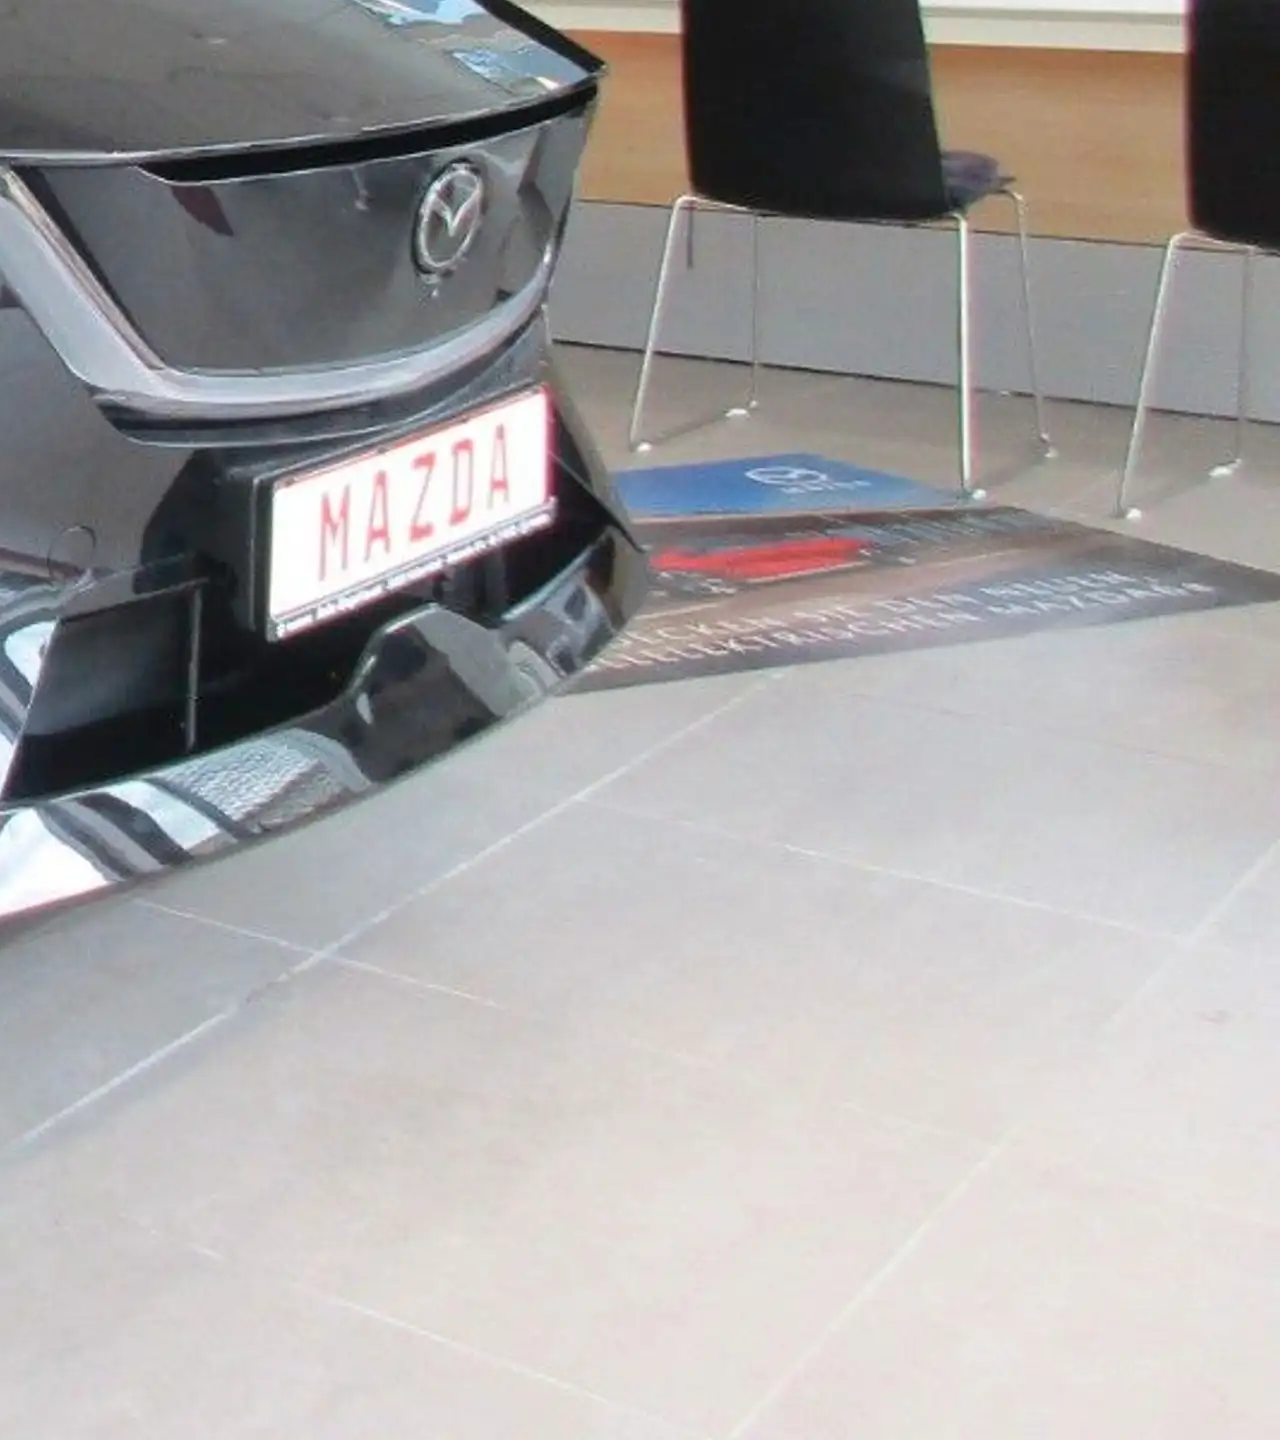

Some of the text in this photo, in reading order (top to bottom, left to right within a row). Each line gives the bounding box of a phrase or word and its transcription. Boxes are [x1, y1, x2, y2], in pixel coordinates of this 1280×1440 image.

[319, 424, 510, 582] MAZDA
[581, 611, 985, 674] LLELEKTRISCHEN
[608, 616, 789, 652] ECKEN
